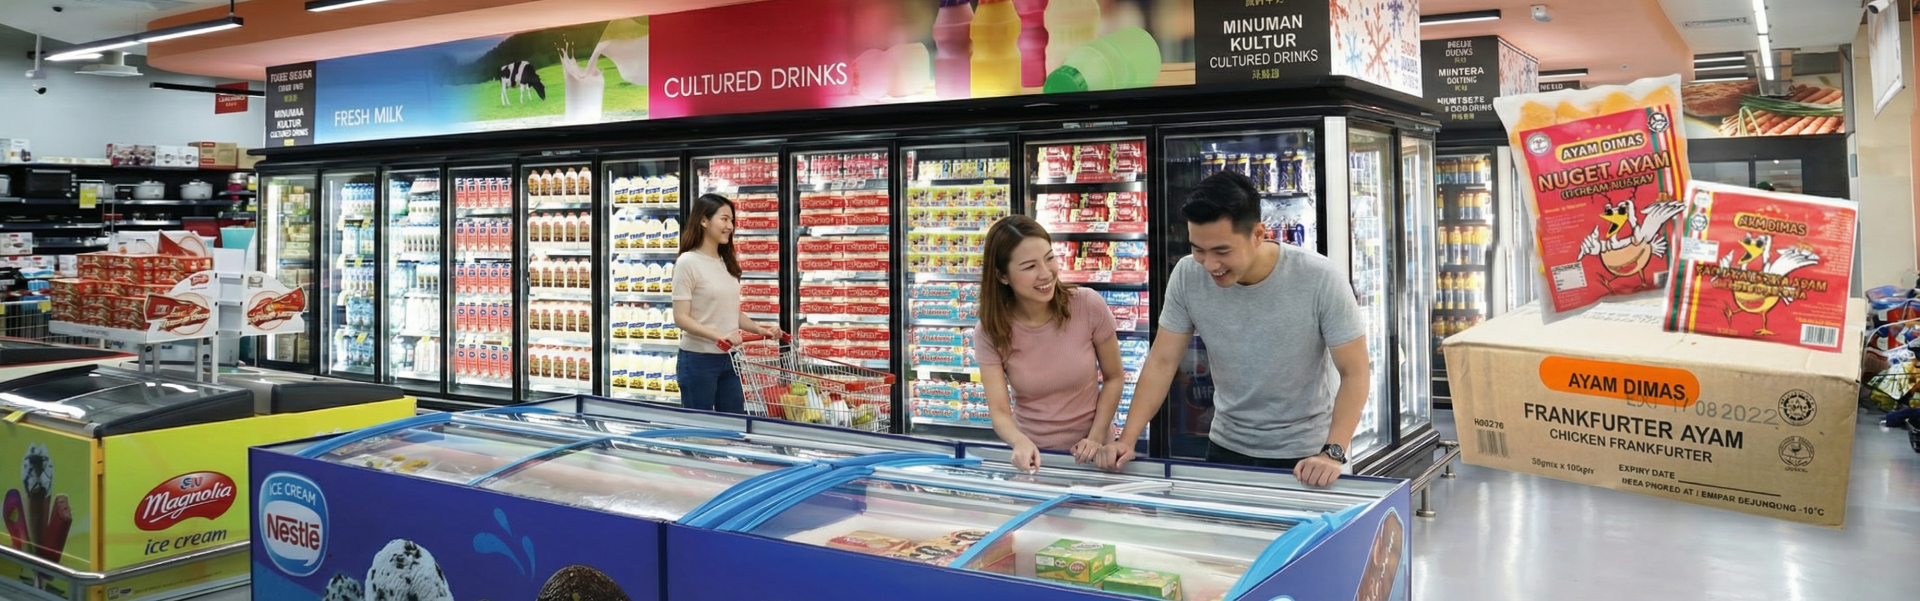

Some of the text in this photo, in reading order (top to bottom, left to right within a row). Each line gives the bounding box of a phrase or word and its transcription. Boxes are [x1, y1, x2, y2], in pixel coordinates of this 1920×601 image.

[1223, 14, 1303, 35] MINUMAN
[1230, 33, 1297, 52] KULTUR
[1209, 49, 1319, 69] CULTURED DRINKS
[664, 62, 848, 98] CULTURED DRINKS
[334, 105, 404, 127] FRESH MILK
[1562, 133, 1645, 161] AYAM DIMAS
[1537, 151, 1671, 192] NUGET AYAM
[1767, 219, 1807, 236] DIMAS
[1568, 373, 1686, 400] AYAM DIMAS
[1695, 400, 1717, 418] 08
[1721, 403, 1780, 425] 2022
[1524, 403, 1744, 450] FRANKFURTER AYAM
[1550, 428, 1713, 464] CHICKEN FRANKFURTER
[1618, 464, 1676, 480] EXPIRY DATE
[142, 482, 233, 521] Magnolia
[269, 482, 317, 506] ICE CREAM
[144, 529, 228, 556] ice cream
